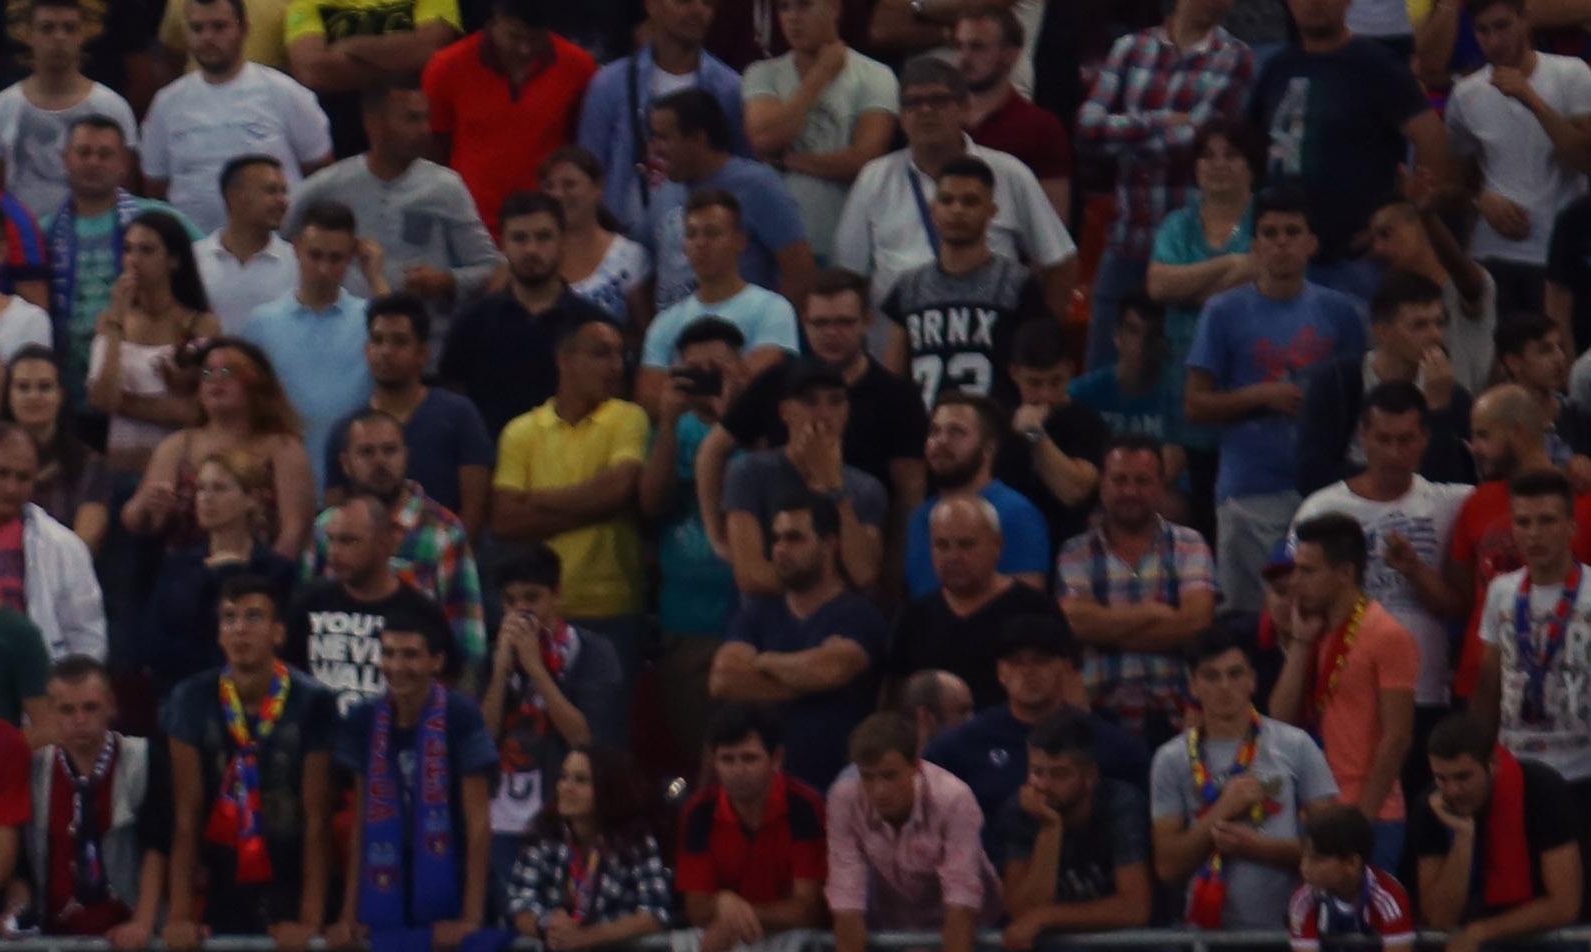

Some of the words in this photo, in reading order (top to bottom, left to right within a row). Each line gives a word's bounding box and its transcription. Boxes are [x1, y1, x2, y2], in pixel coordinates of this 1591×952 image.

[308, 611, 386, 635] YOU'
[308, 634, 383, 664] NEV
[312, 662, 389, 694] WAL
